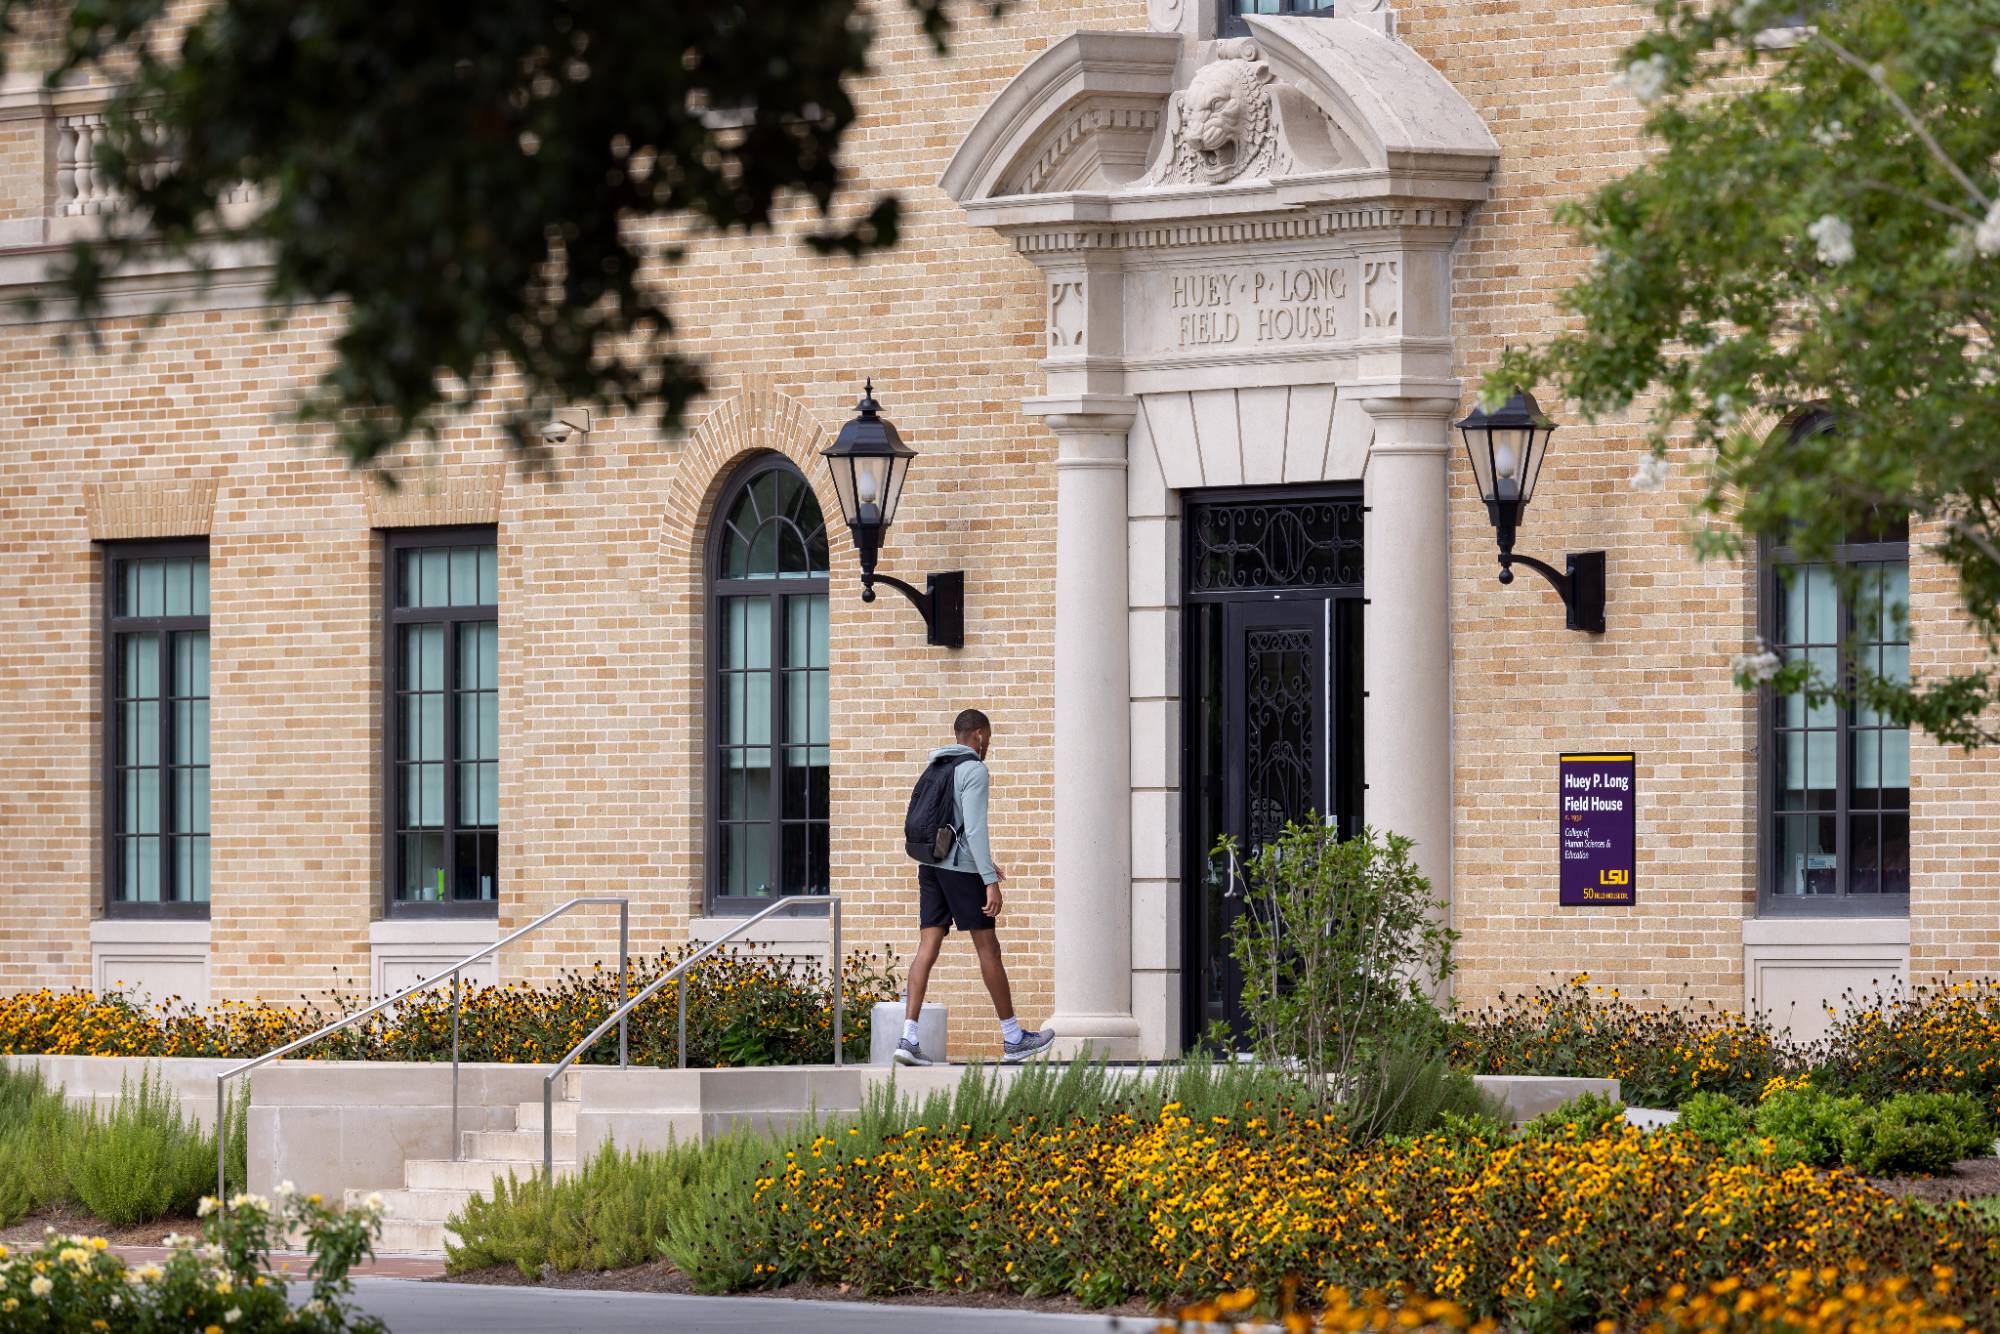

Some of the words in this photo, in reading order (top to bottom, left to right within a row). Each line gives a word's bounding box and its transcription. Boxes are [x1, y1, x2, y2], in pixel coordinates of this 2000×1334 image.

[1280, 267, 1347, 302] LONG
[1178, 312, 1240, 346] FIELD
[1257, 305, 1337, 341] HOUSE
[1565, 774, 1591, 791] Huey
[1593, 773, 1602, 788] P.
[1604, 773, 1628, 791] Long
[1565, 796, 1588, 811] Field
[1591, 797, 1622, 811] House
[1565, 828, 1583, 839] College
[1584, 828, 1590, 839] of
[1565, 840, 1583, 848] Human
[1584, 840, 1605, 848] Sciences
[1565, 850, 1589, 860] Education
[1600, 870, 1628, 885] LSU
[1583, 888, 1594, 900] 50
